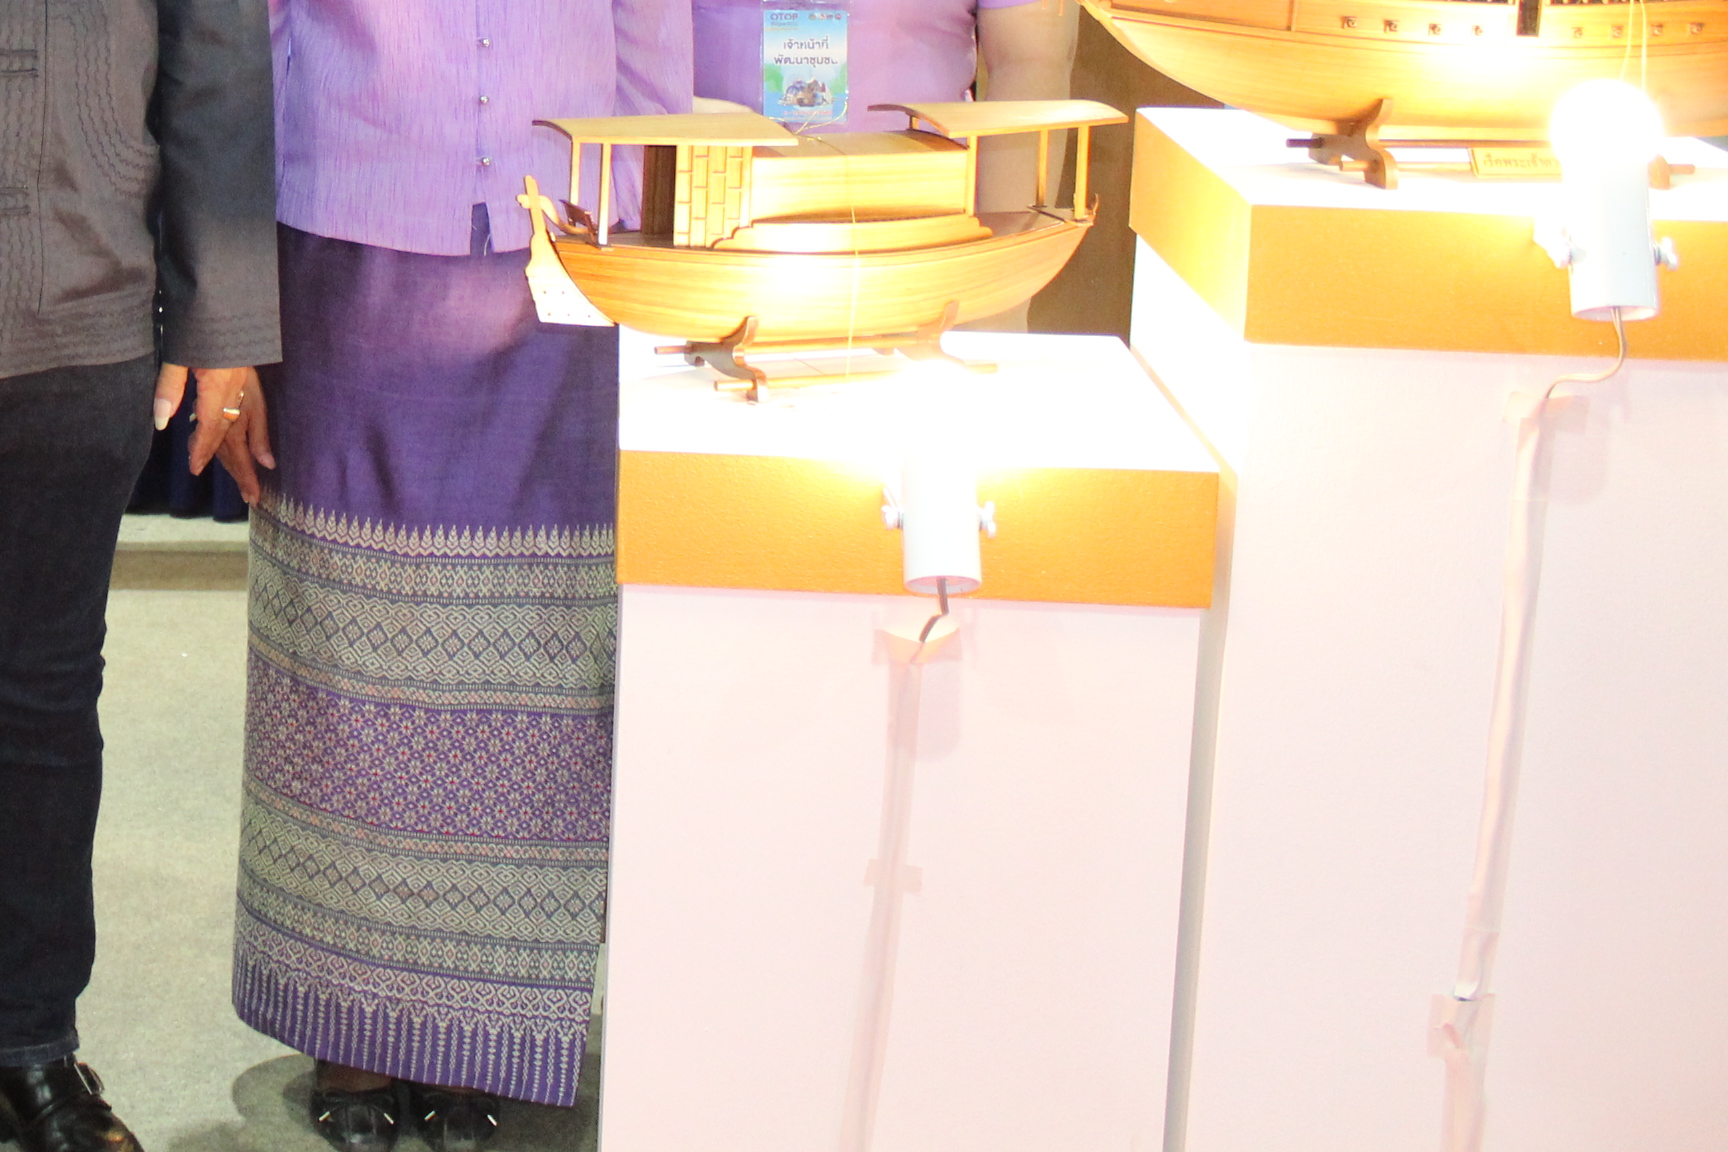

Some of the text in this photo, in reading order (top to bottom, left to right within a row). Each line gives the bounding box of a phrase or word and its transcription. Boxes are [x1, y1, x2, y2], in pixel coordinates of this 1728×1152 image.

[770, 13, 799, 21] OTOP
[783, 35, 829, 49] เจ้าหน้าที่
